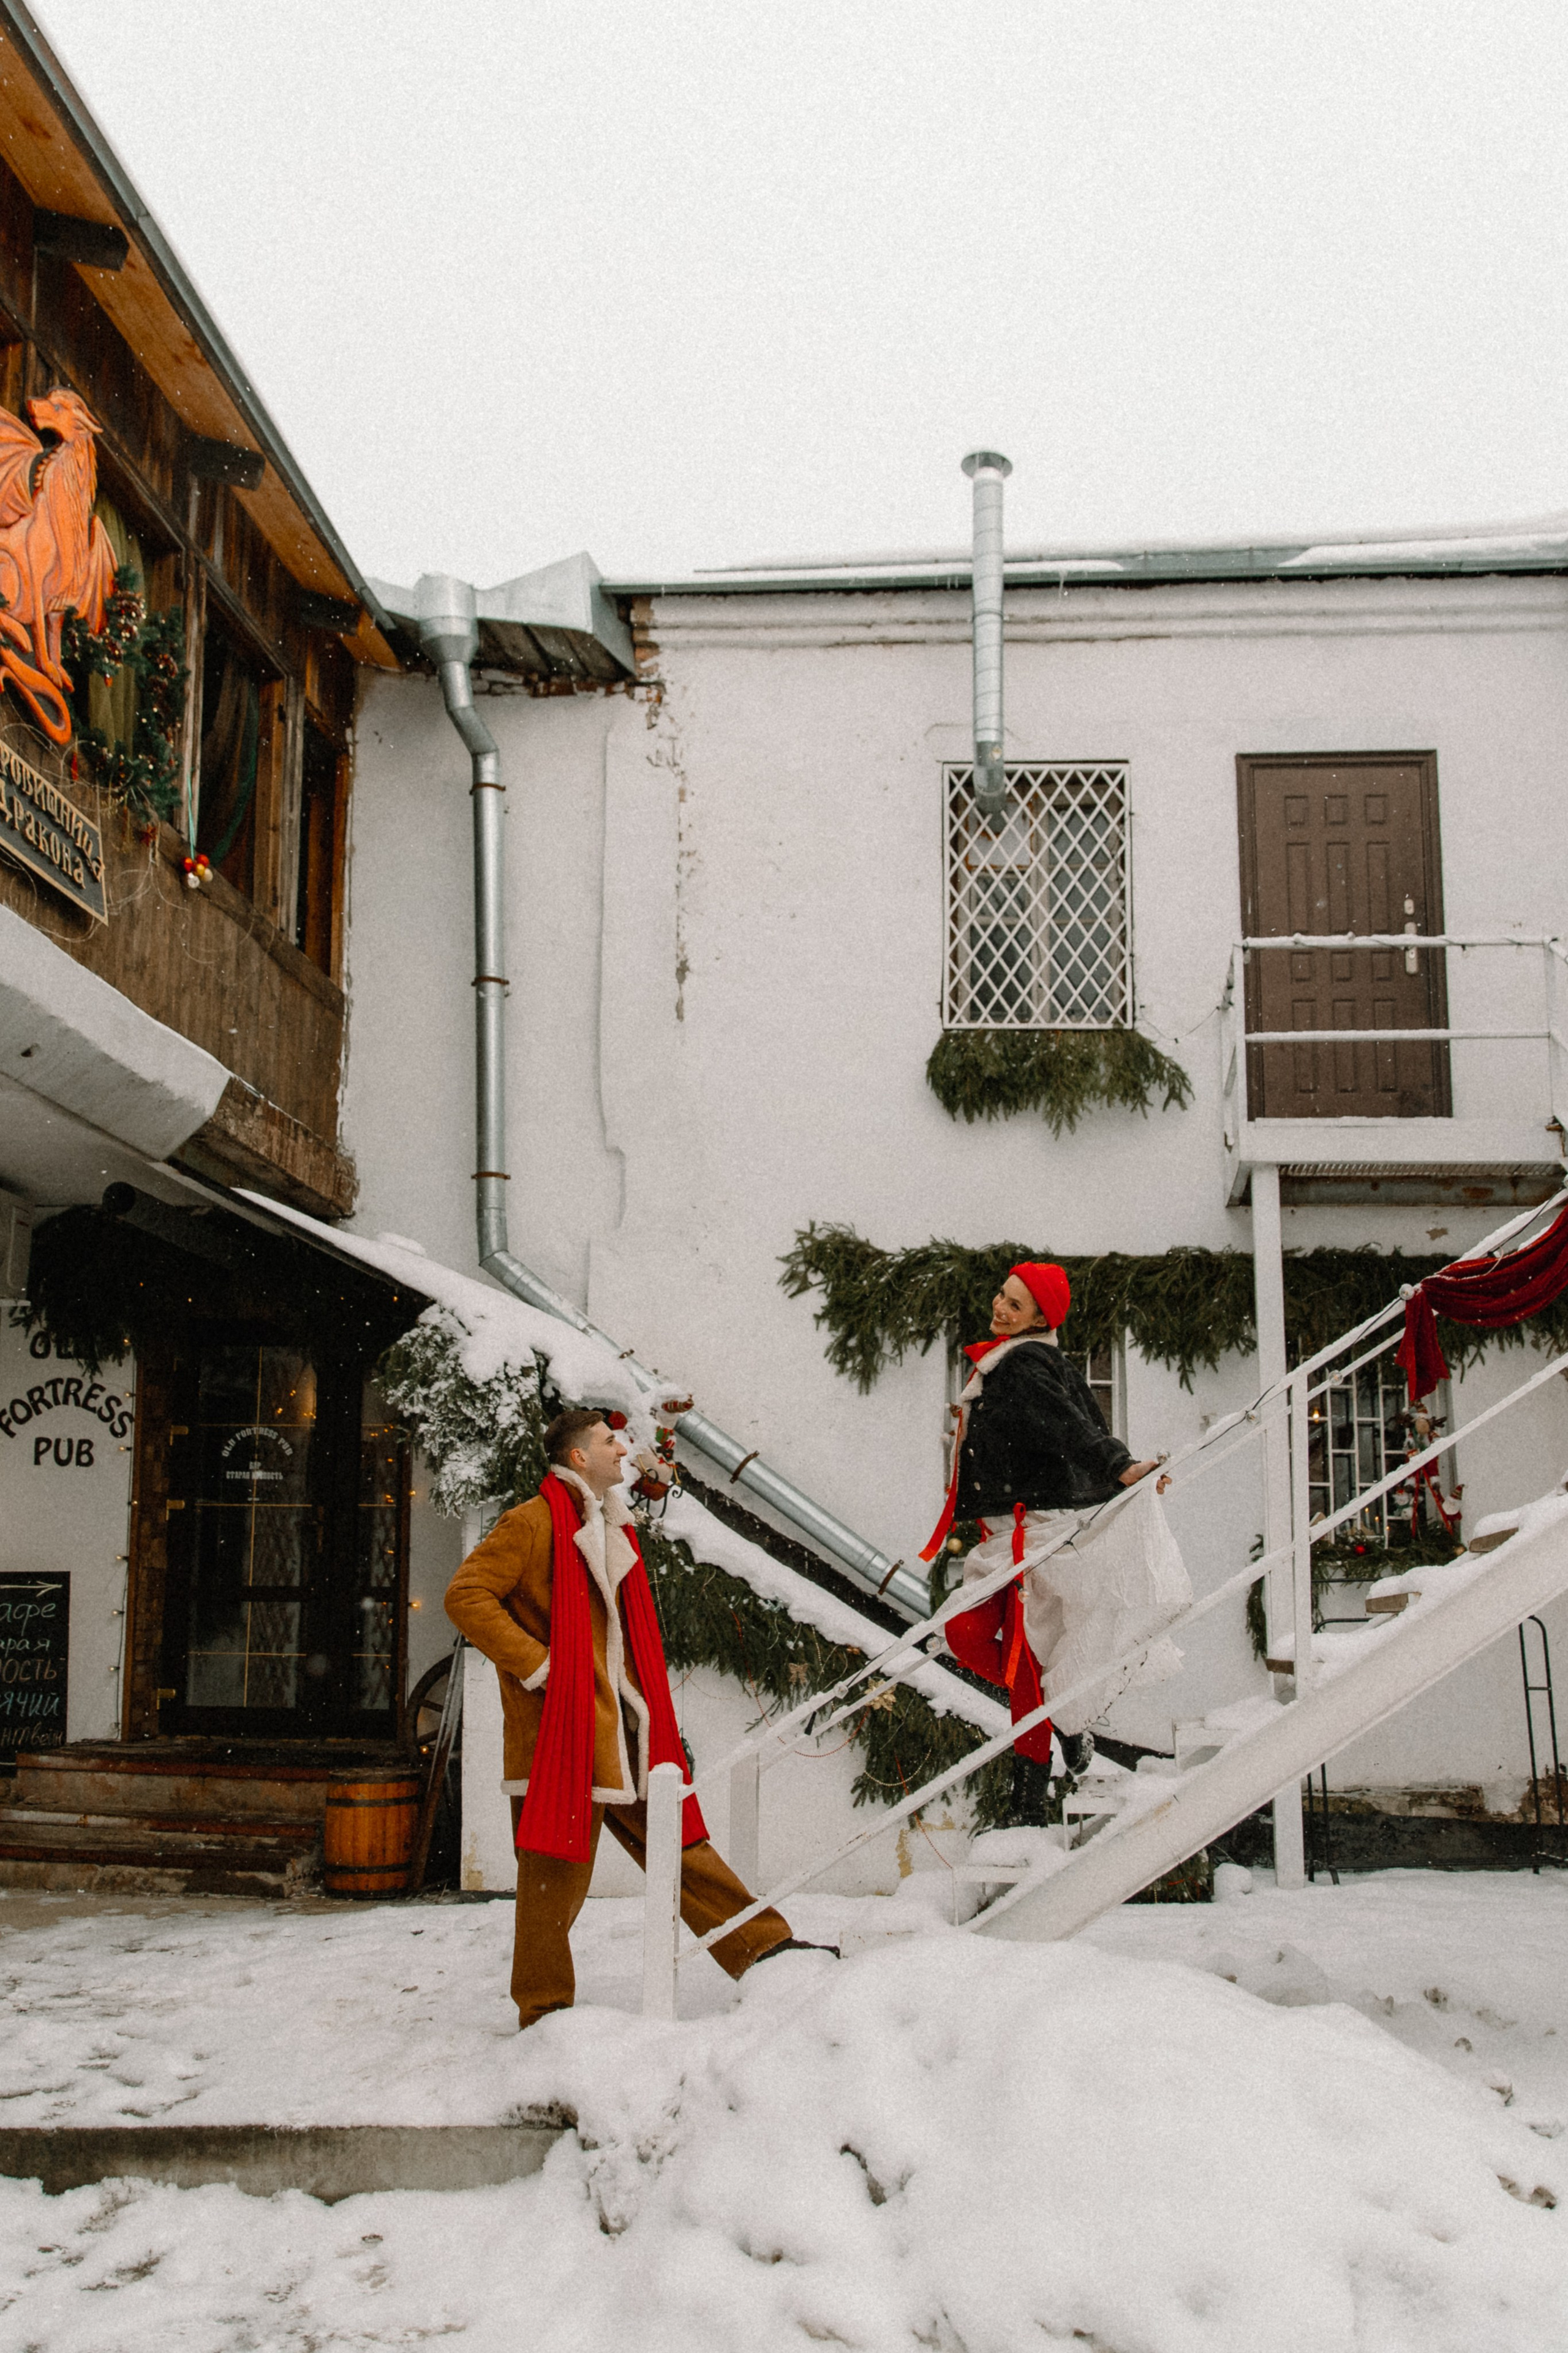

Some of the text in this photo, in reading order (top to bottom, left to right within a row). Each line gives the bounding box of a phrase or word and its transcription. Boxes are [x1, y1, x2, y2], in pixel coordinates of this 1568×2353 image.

[0, 1377, 134, 1438] FORTRESS
[34, 1437, 94, 1467] PUB
[235, 1427, 279, 1441] FORTRESS
[277, 1437, 293, 1456] PUB
